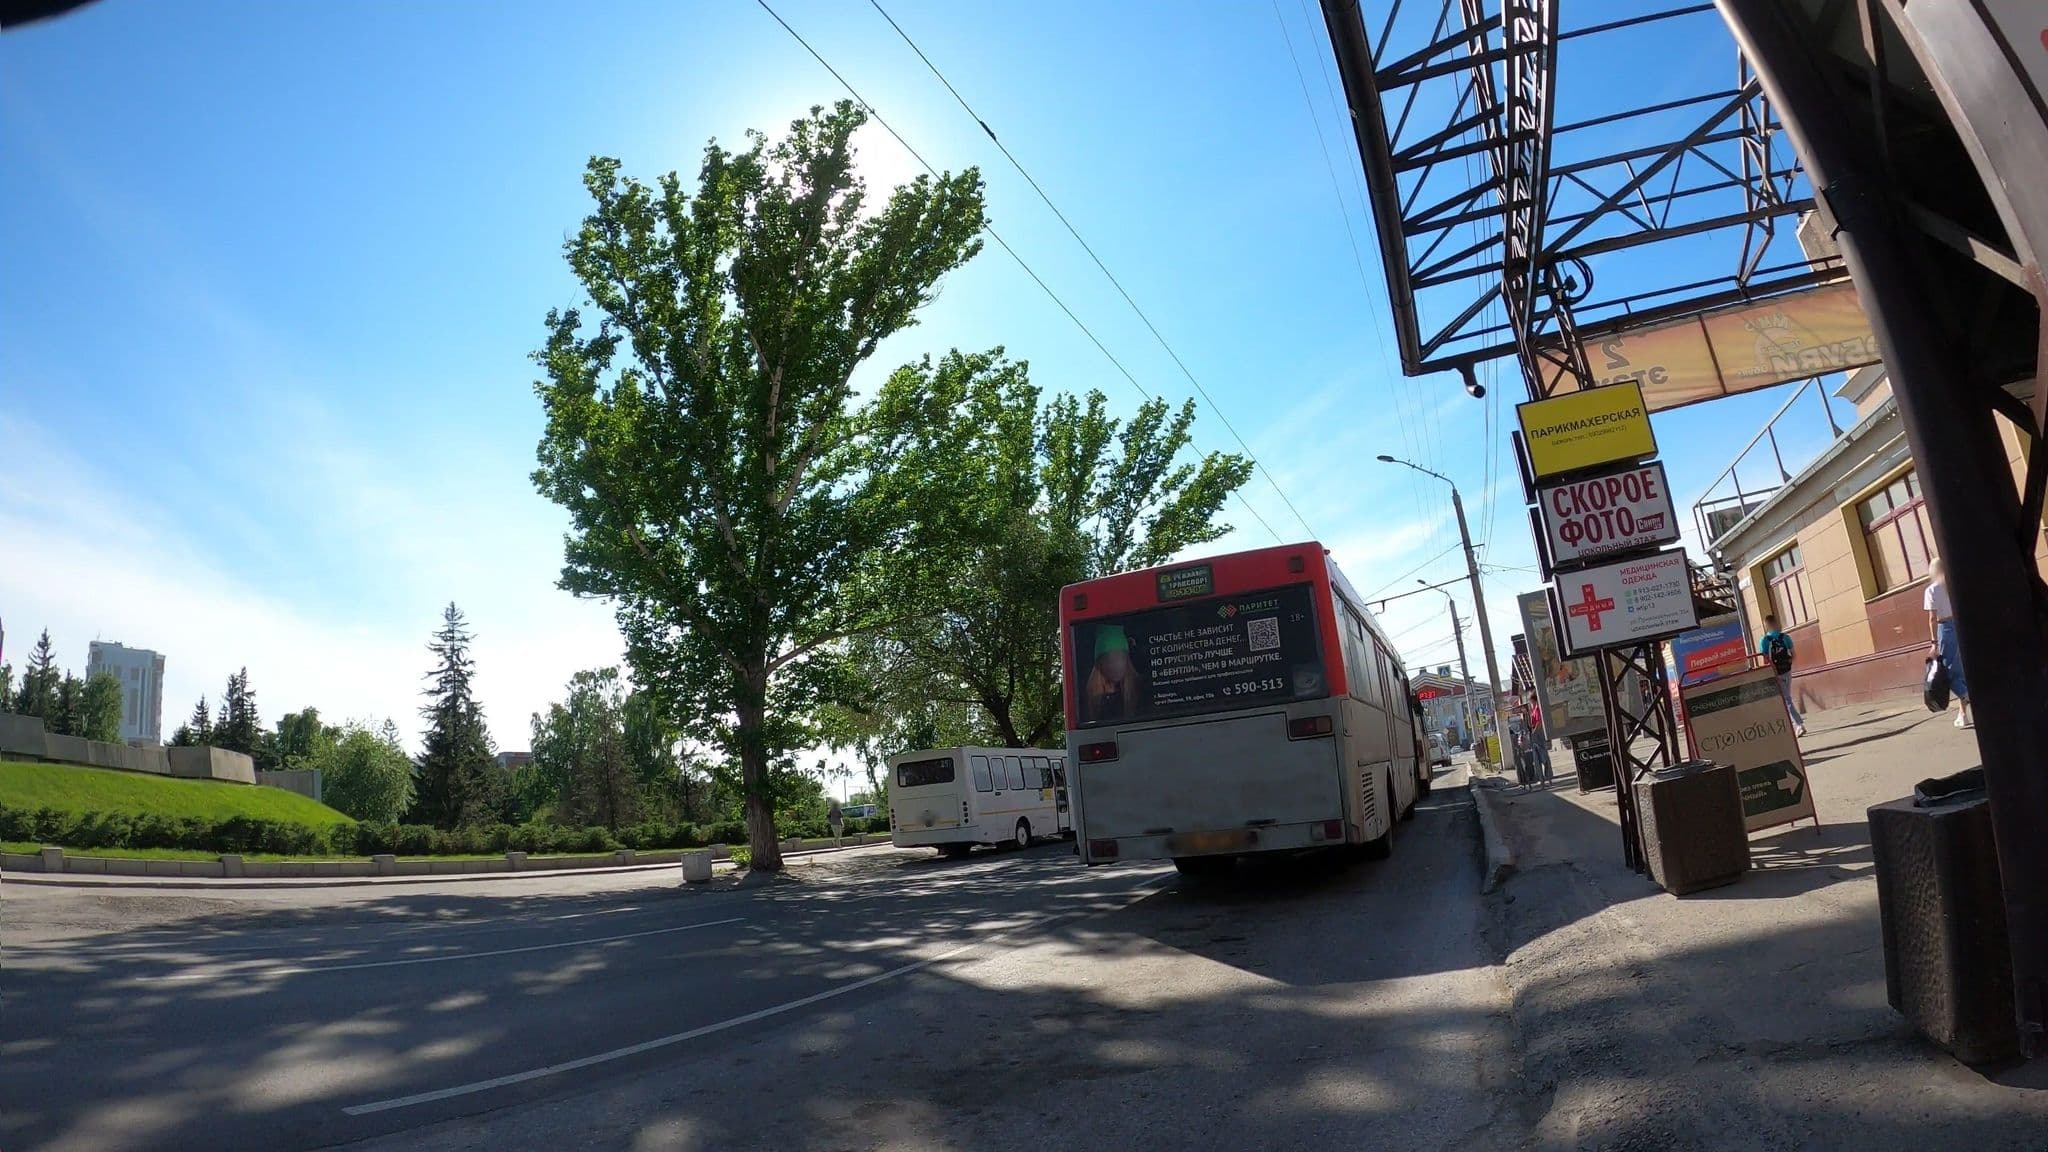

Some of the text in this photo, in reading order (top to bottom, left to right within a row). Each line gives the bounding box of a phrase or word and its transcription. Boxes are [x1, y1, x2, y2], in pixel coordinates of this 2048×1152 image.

[1530, 408, 1640, 439] ПАРИКМАХЕРСКАЯ
[1553, 470, 1658, 517] СКОРОЕ
[1559, 507, 1635, 547] ФОТО
[1578, 534, 1657, 556] ЦОКОЛЬНЫЙ ЭТАЖ
[1619, 559, 1680, 575] МЕДИЦИНСКАЯ
[1622, 572, 1657, 585] ОДЕЖДА
[1240, 600, 1279, 611] ПАРИТЕТ
[1290, 613, 1305, 622] 18+
[1149, 624, 1234, 644] СЧАСТЬЕ НЕ ЗАВИСИТ
[1150, 646, 1161, 655] ОТ
[1163, 639, 1213, 653] КОЛИЧЕСТВА
[1151, 647, 1233, 667] НО ГРУСТИТЬ ЛУЧШЕ
[1152, 670, 1158, 678] В
[1202, 661, 1219, 671] ЧЕМ
[1221, 660, 1227, 669] В
[1228, 652, 1282, 667] МАРШРУТКЕ.
[1691, 651, 1718, 668] Первый
[1235, 678, 1284, 694] 590-513
[1701, 719, 1786, 752] СТОЛОВАЯ
